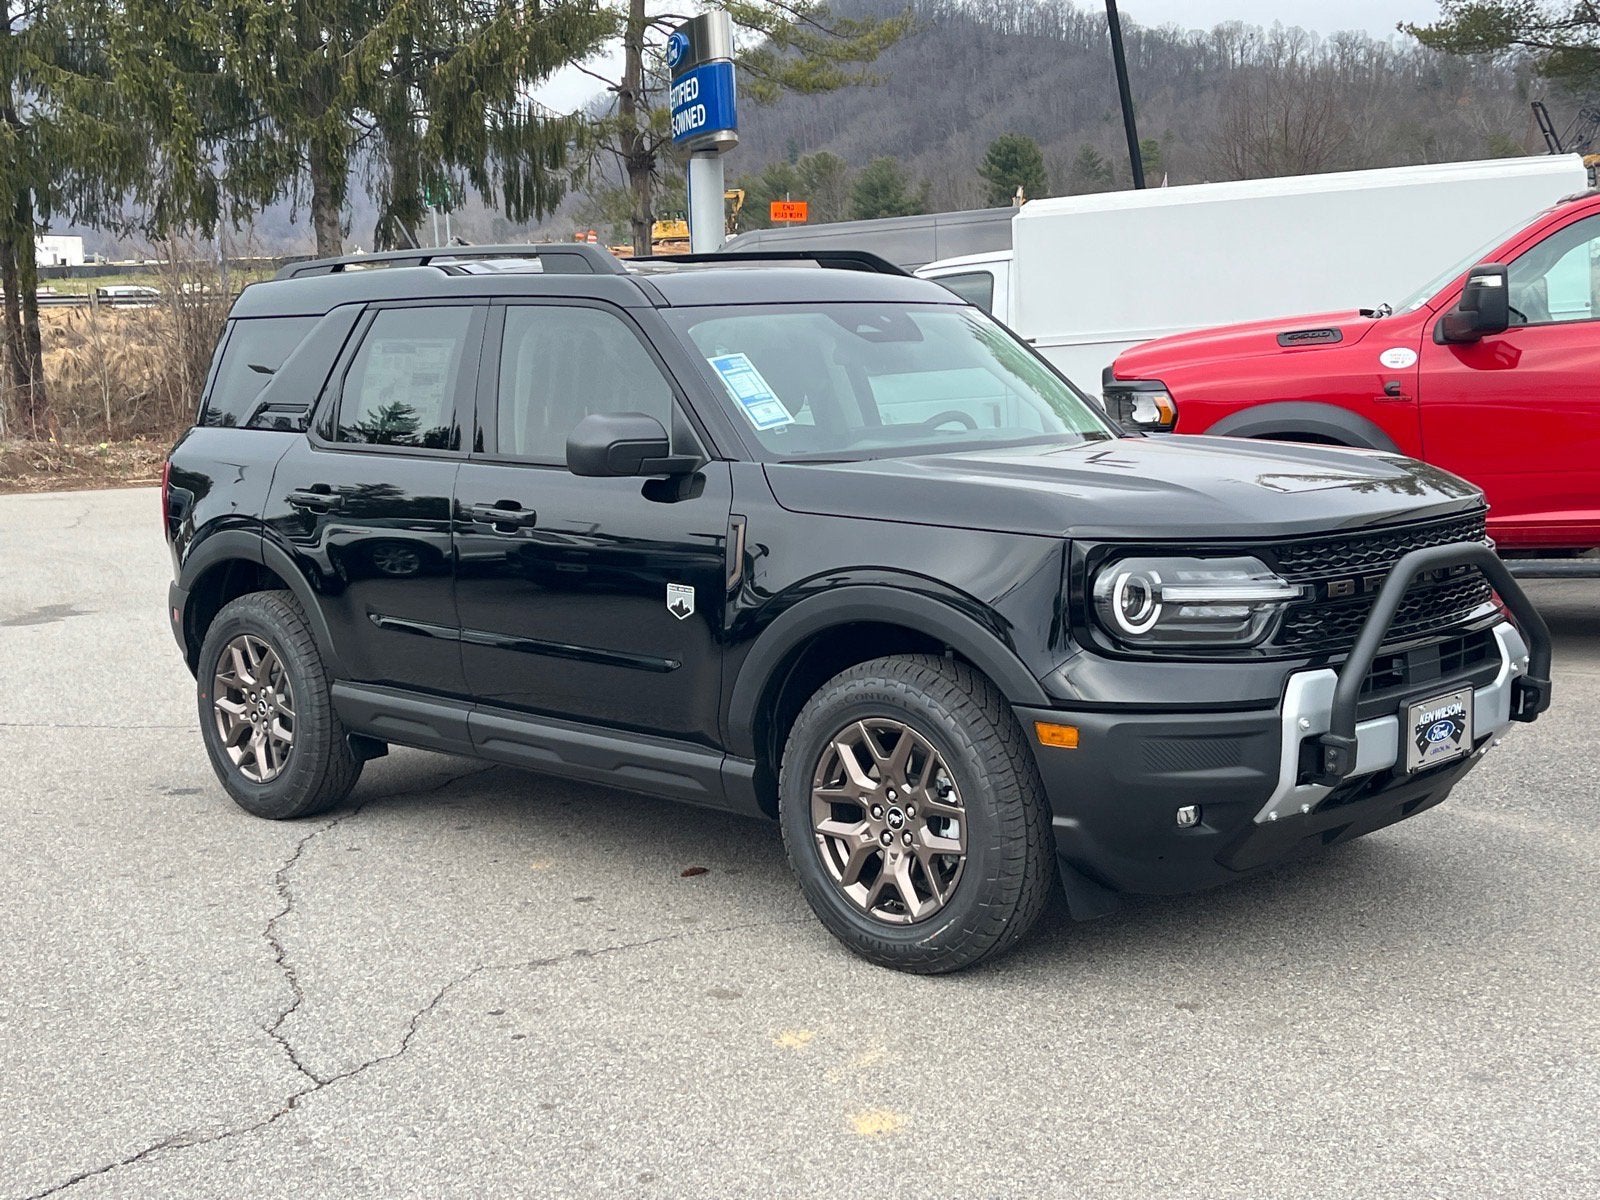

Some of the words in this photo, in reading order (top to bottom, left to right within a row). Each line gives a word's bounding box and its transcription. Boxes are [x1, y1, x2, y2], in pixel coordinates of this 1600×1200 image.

[789, 211, 803, 219] WORK
[1419, 711, 1435, 726] KEN
[1434, 702, 1462, 720] WILSON
[1431, 723, 1450, 741] Ford
